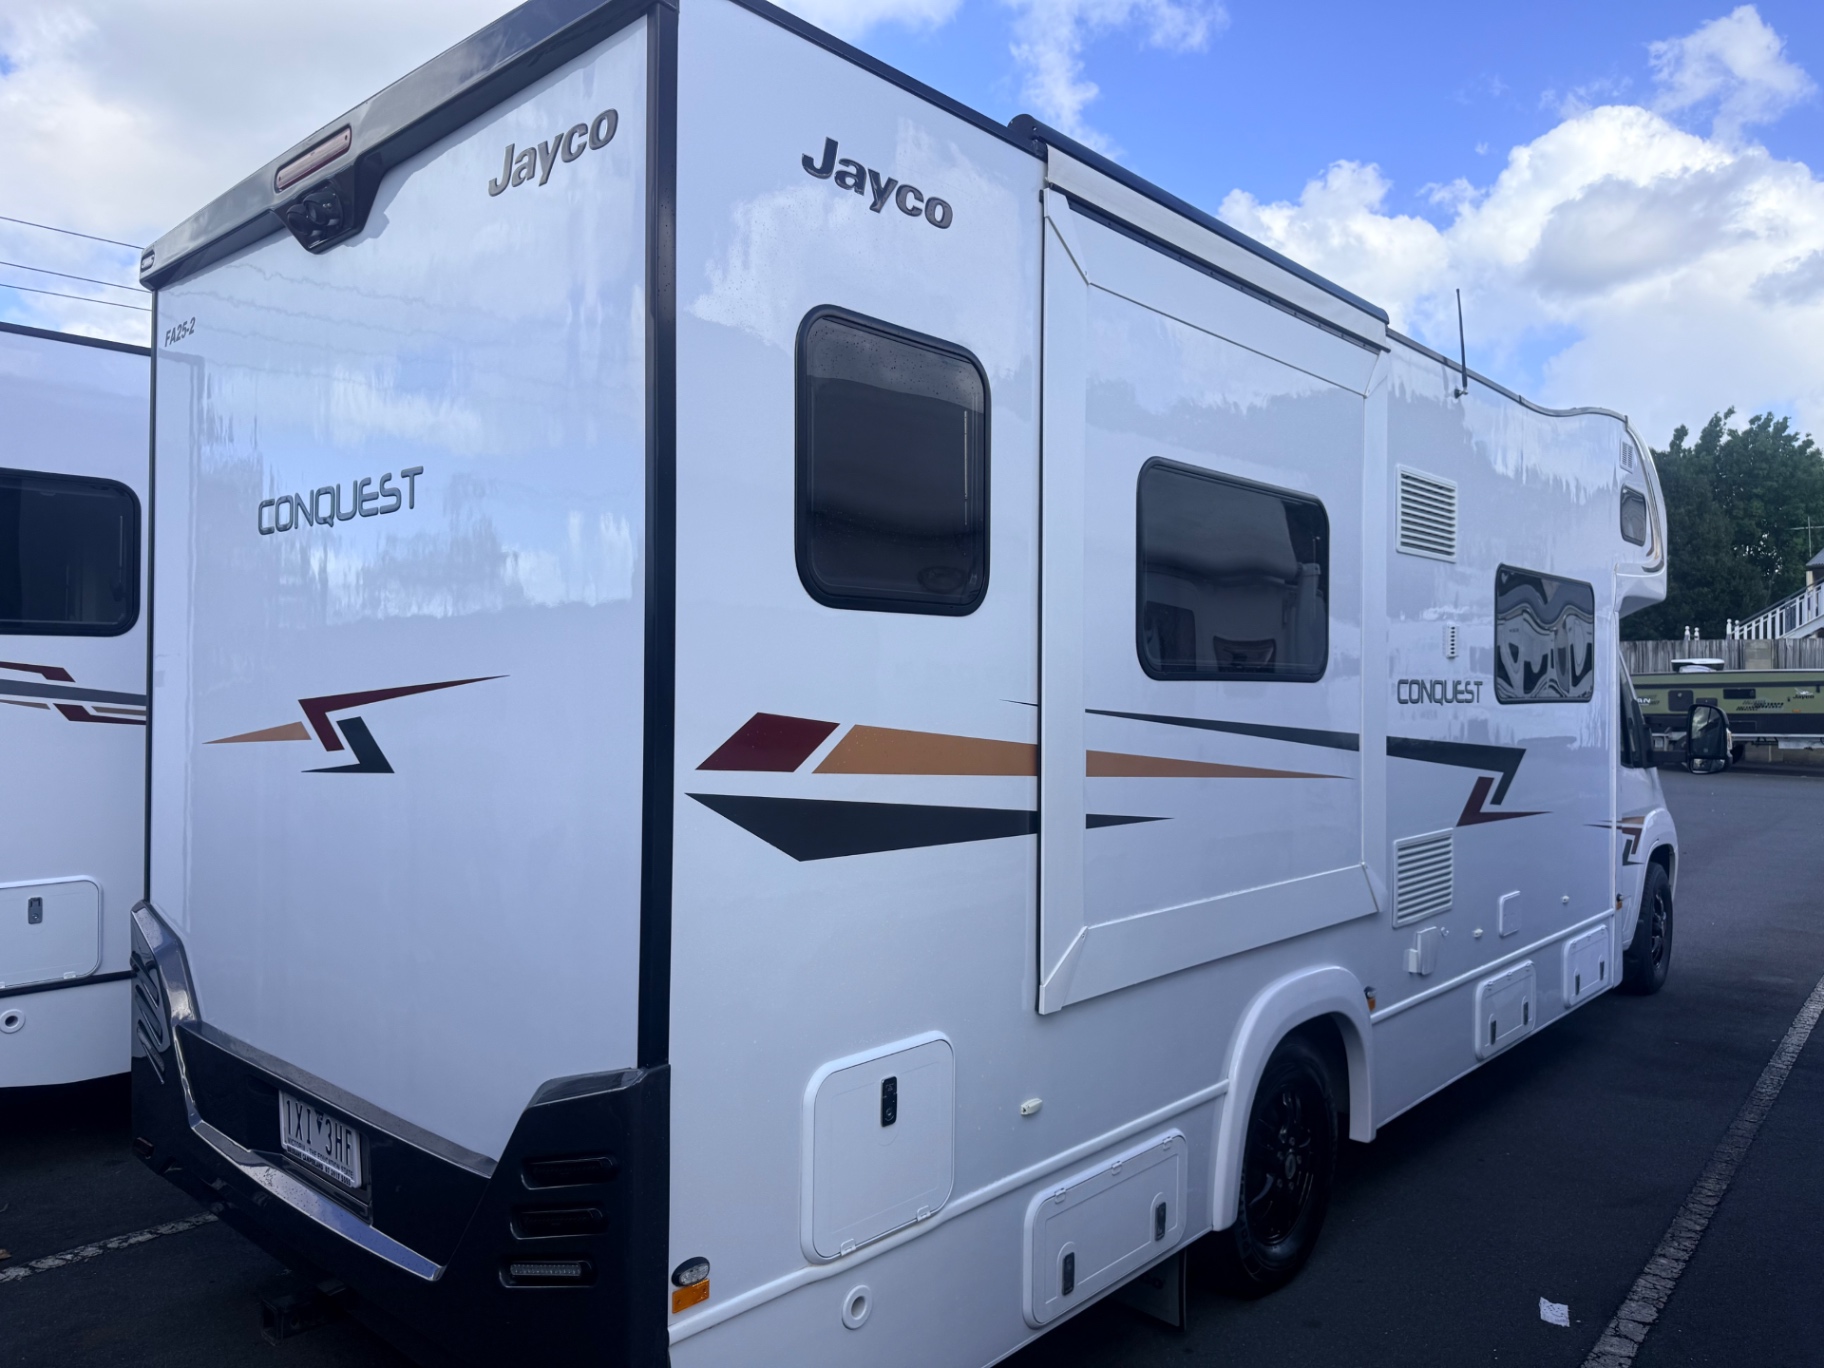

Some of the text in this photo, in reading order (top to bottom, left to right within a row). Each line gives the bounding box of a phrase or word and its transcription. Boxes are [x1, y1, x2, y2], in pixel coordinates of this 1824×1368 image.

[488, 108, 619, 197] Jayco
[801, 136, 954, 229] Jayco
[164, 316, 196, 347] FA25-2
[257, 466, 424, 536] CONQUEST
[1396, 677, 1483, 708] CONQUEST
